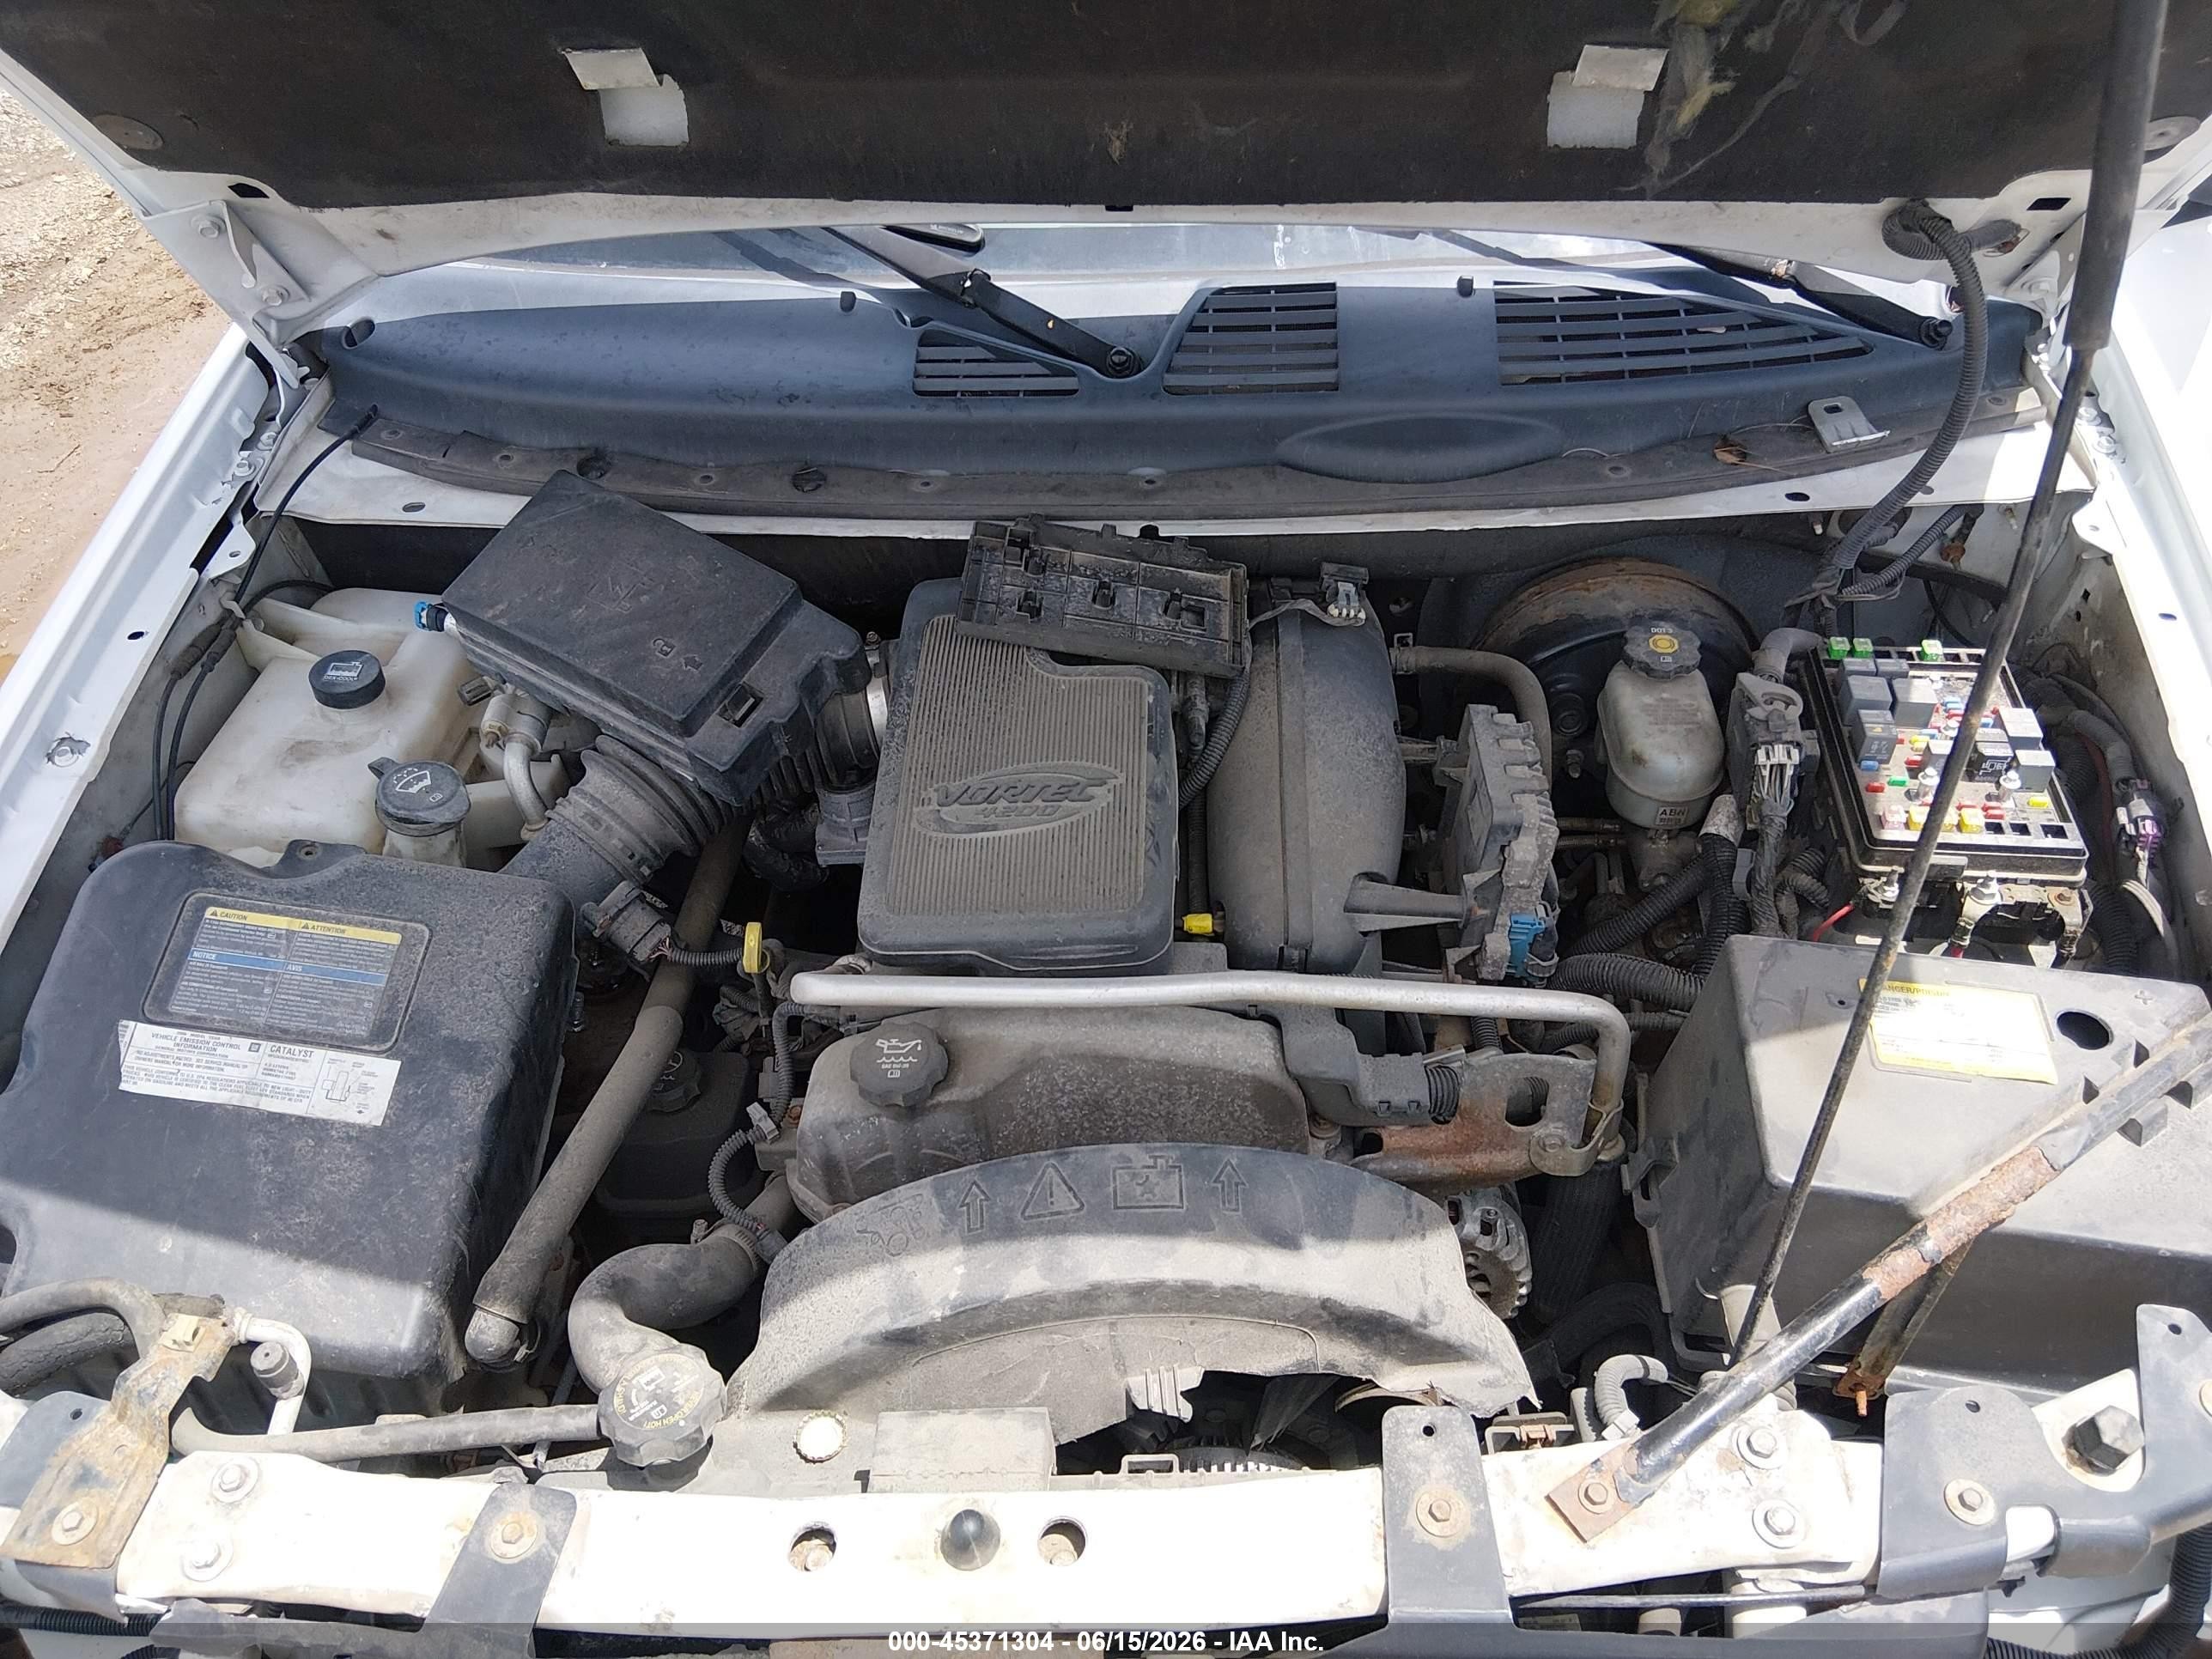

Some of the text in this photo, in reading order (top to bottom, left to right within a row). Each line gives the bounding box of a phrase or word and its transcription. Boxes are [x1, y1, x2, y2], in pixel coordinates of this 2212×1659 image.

[934, 781, 1108, 807] VORTEC
[220, 911, 247, 921] CAUTION
[311, 925, 347, 934] ATTENTION
[192, 951, 216, 961] NOTICE
[286, 963, 303, 972] AVIS
[151, 1032, 178, 1042] VEHICLE
[179, 1036, 210, 1046] EMISSION
[212, 1040, 241, 1050] CONTROL
[173, 1042, 218, 1052] INFORMATION
[270, 1044, 315, 1058] CATALYST
